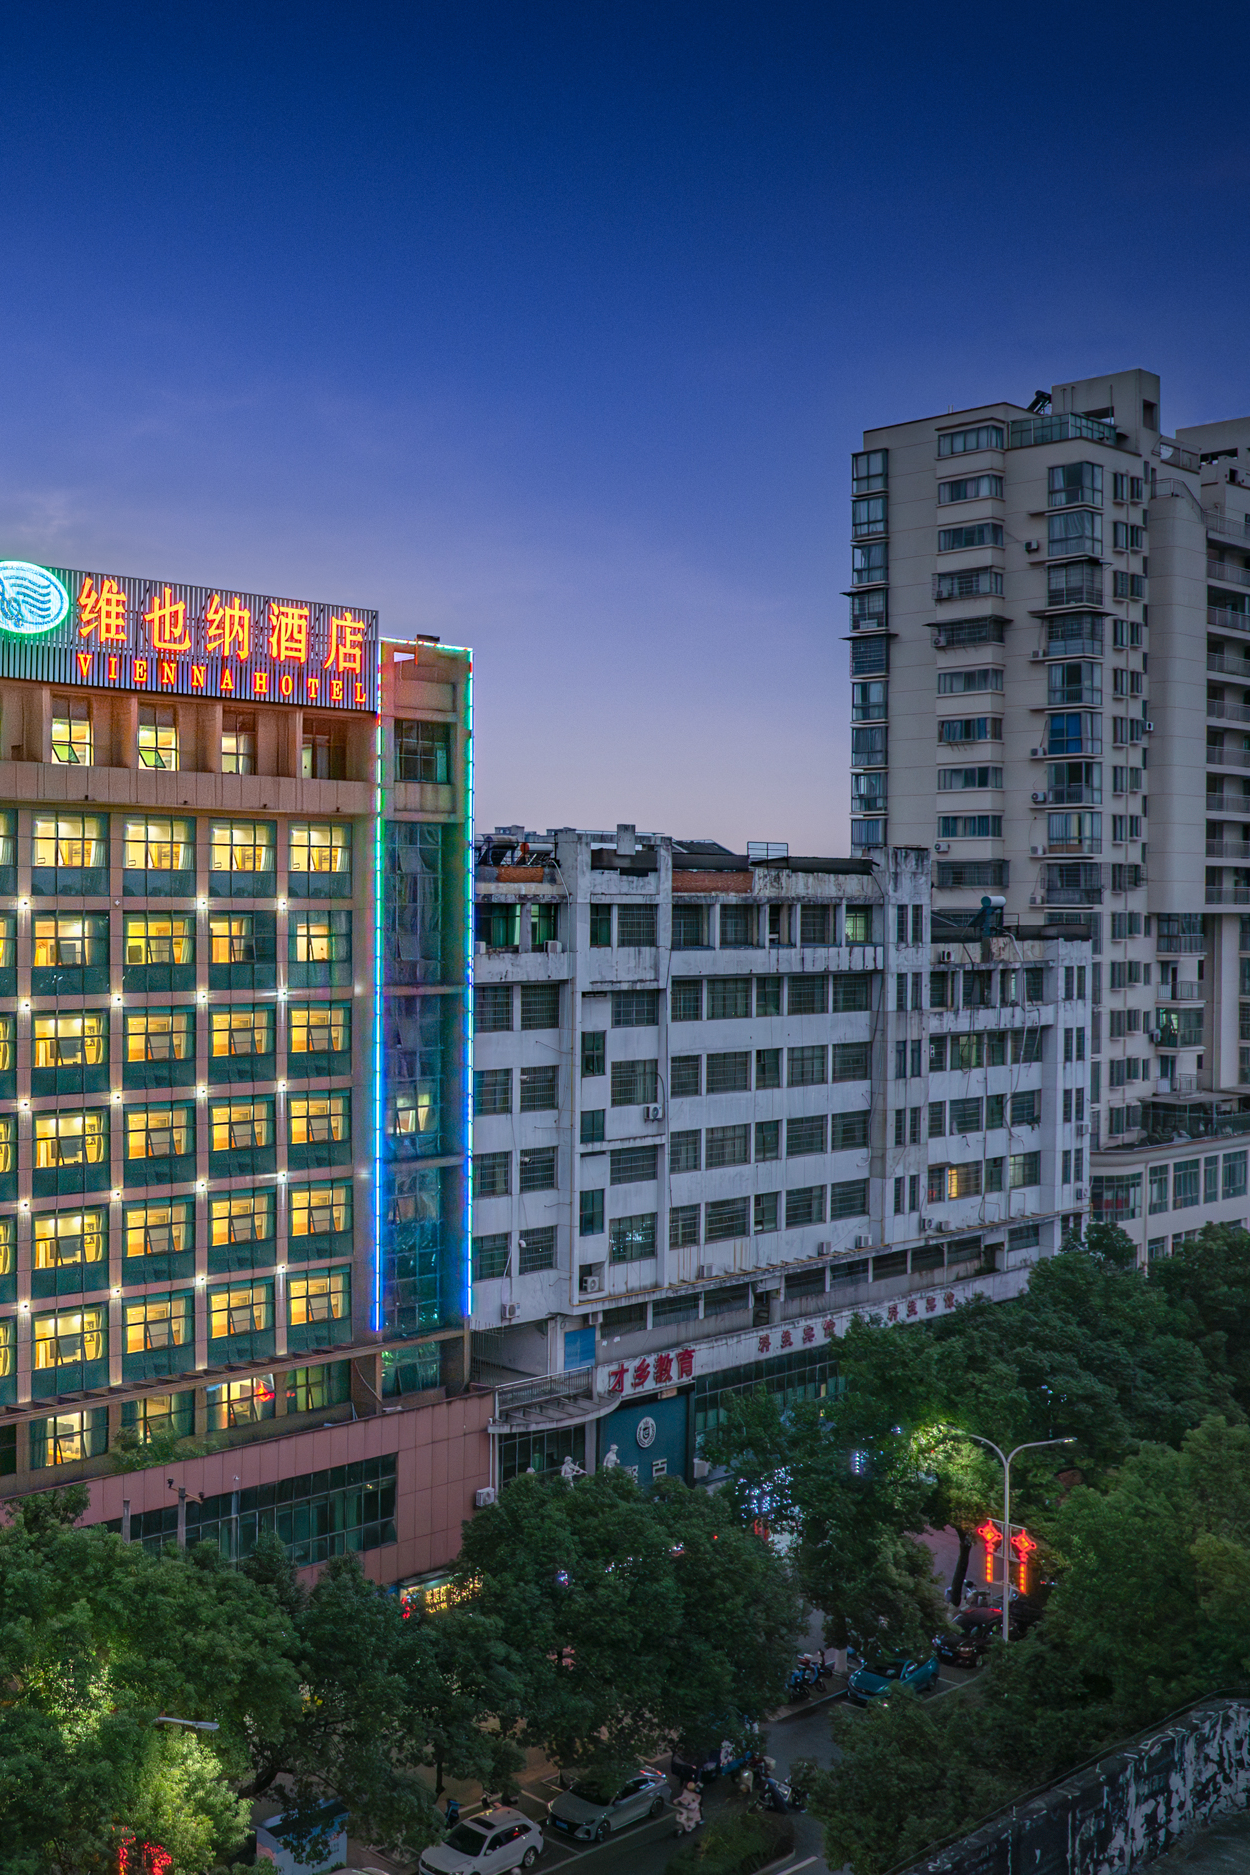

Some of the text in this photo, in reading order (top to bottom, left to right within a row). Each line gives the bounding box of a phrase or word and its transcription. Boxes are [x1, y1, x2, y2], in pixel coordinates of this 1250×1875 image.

[77, 576, 366, 674] 维也纳酒店
[608, 1348, 696, 1393] 才乡教育
